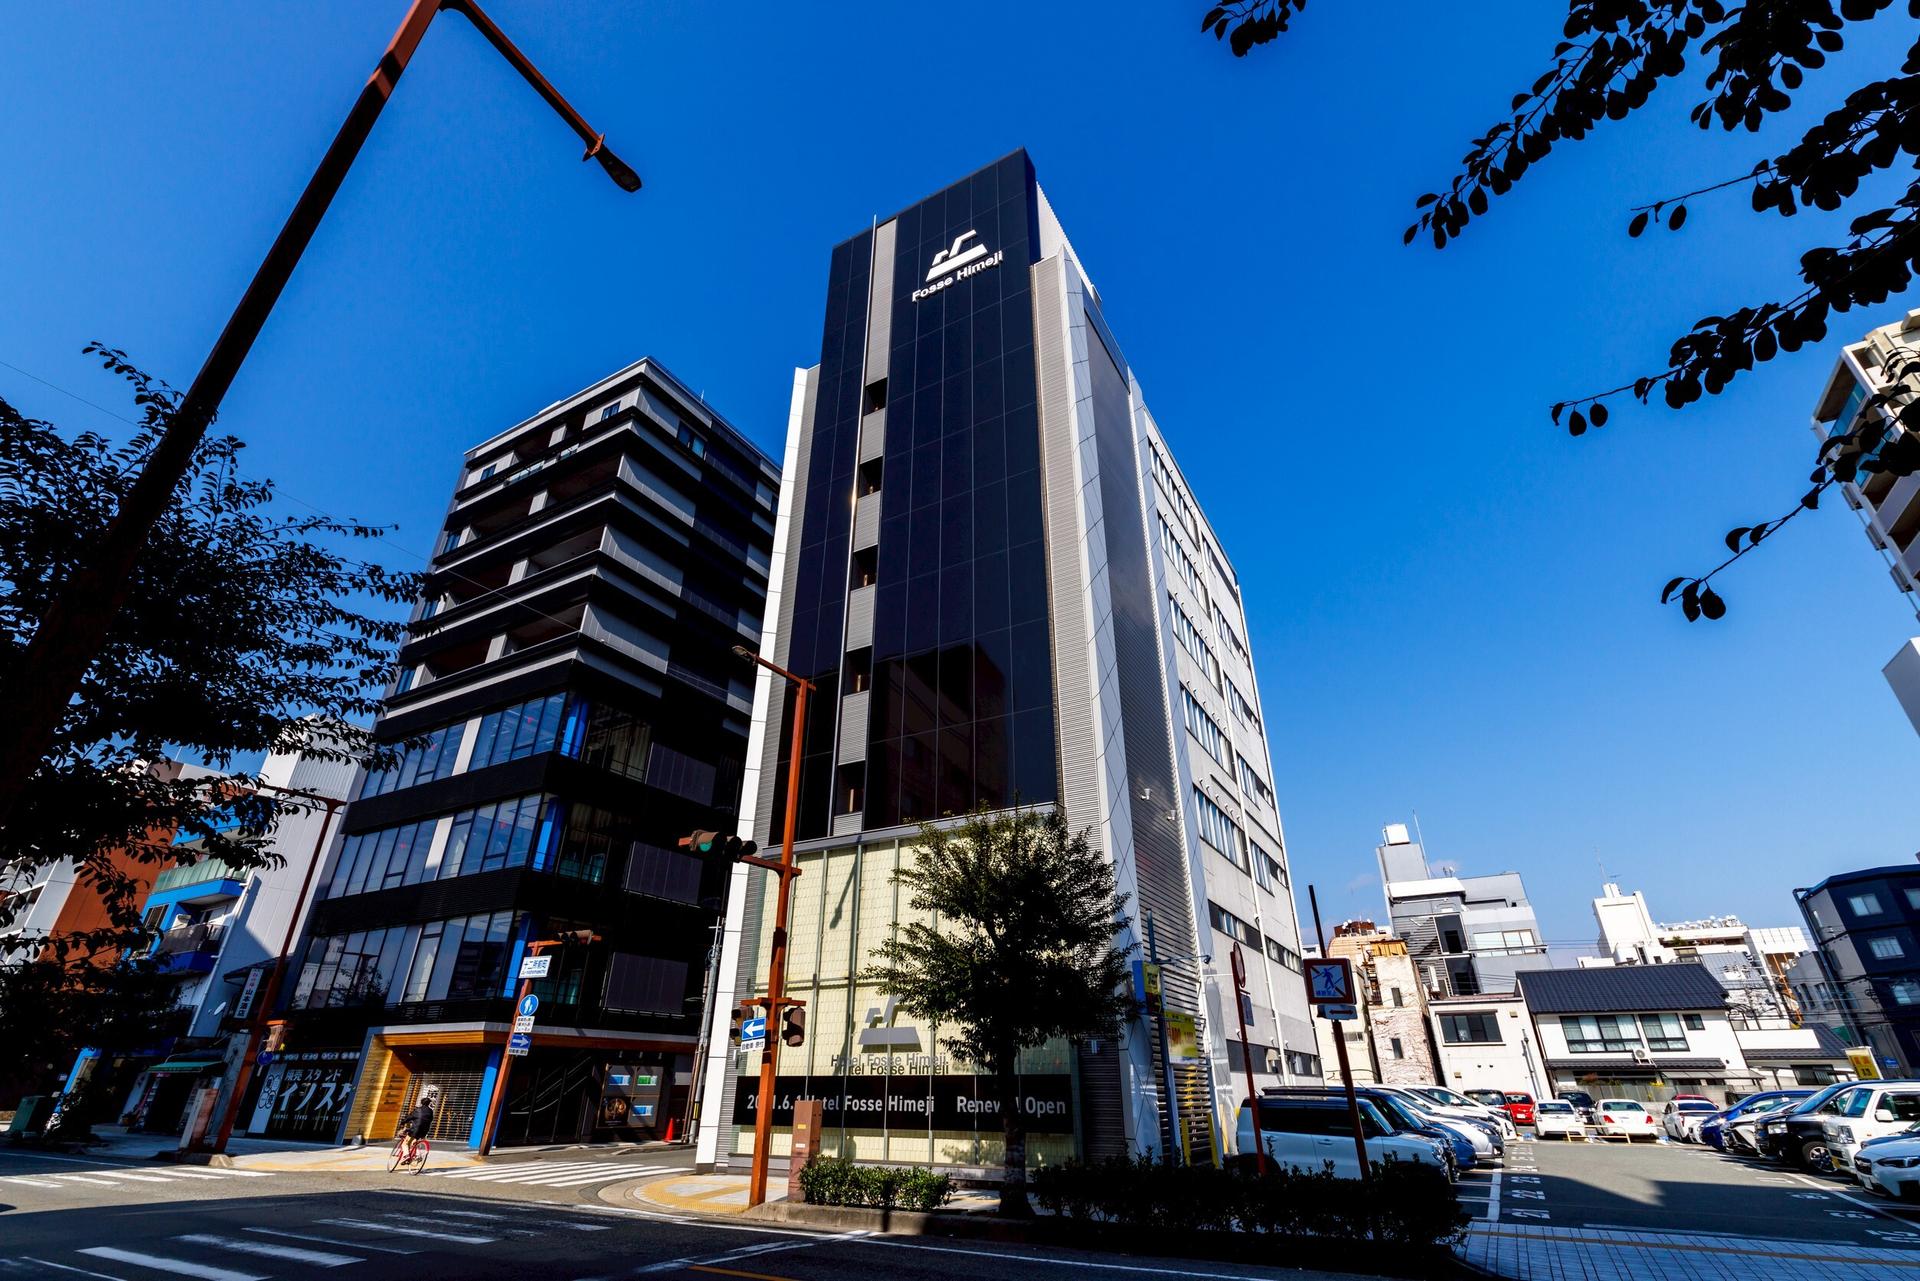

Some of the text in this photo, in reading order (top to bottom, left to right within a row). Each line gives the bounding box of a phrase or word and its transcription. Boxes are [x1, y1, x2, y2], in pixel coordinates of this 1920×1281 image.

[912, 250, 1003, 302] Fosse Himeji
[867, 1053, 902, 1066] Fosse
[906, 1052, 947, 1068] Himeji
[844, 1095, 883, 1112] Fosse
[888, 1095, 935, 1115] Himeji
[1025, 1096, 1066, 1118] Open
